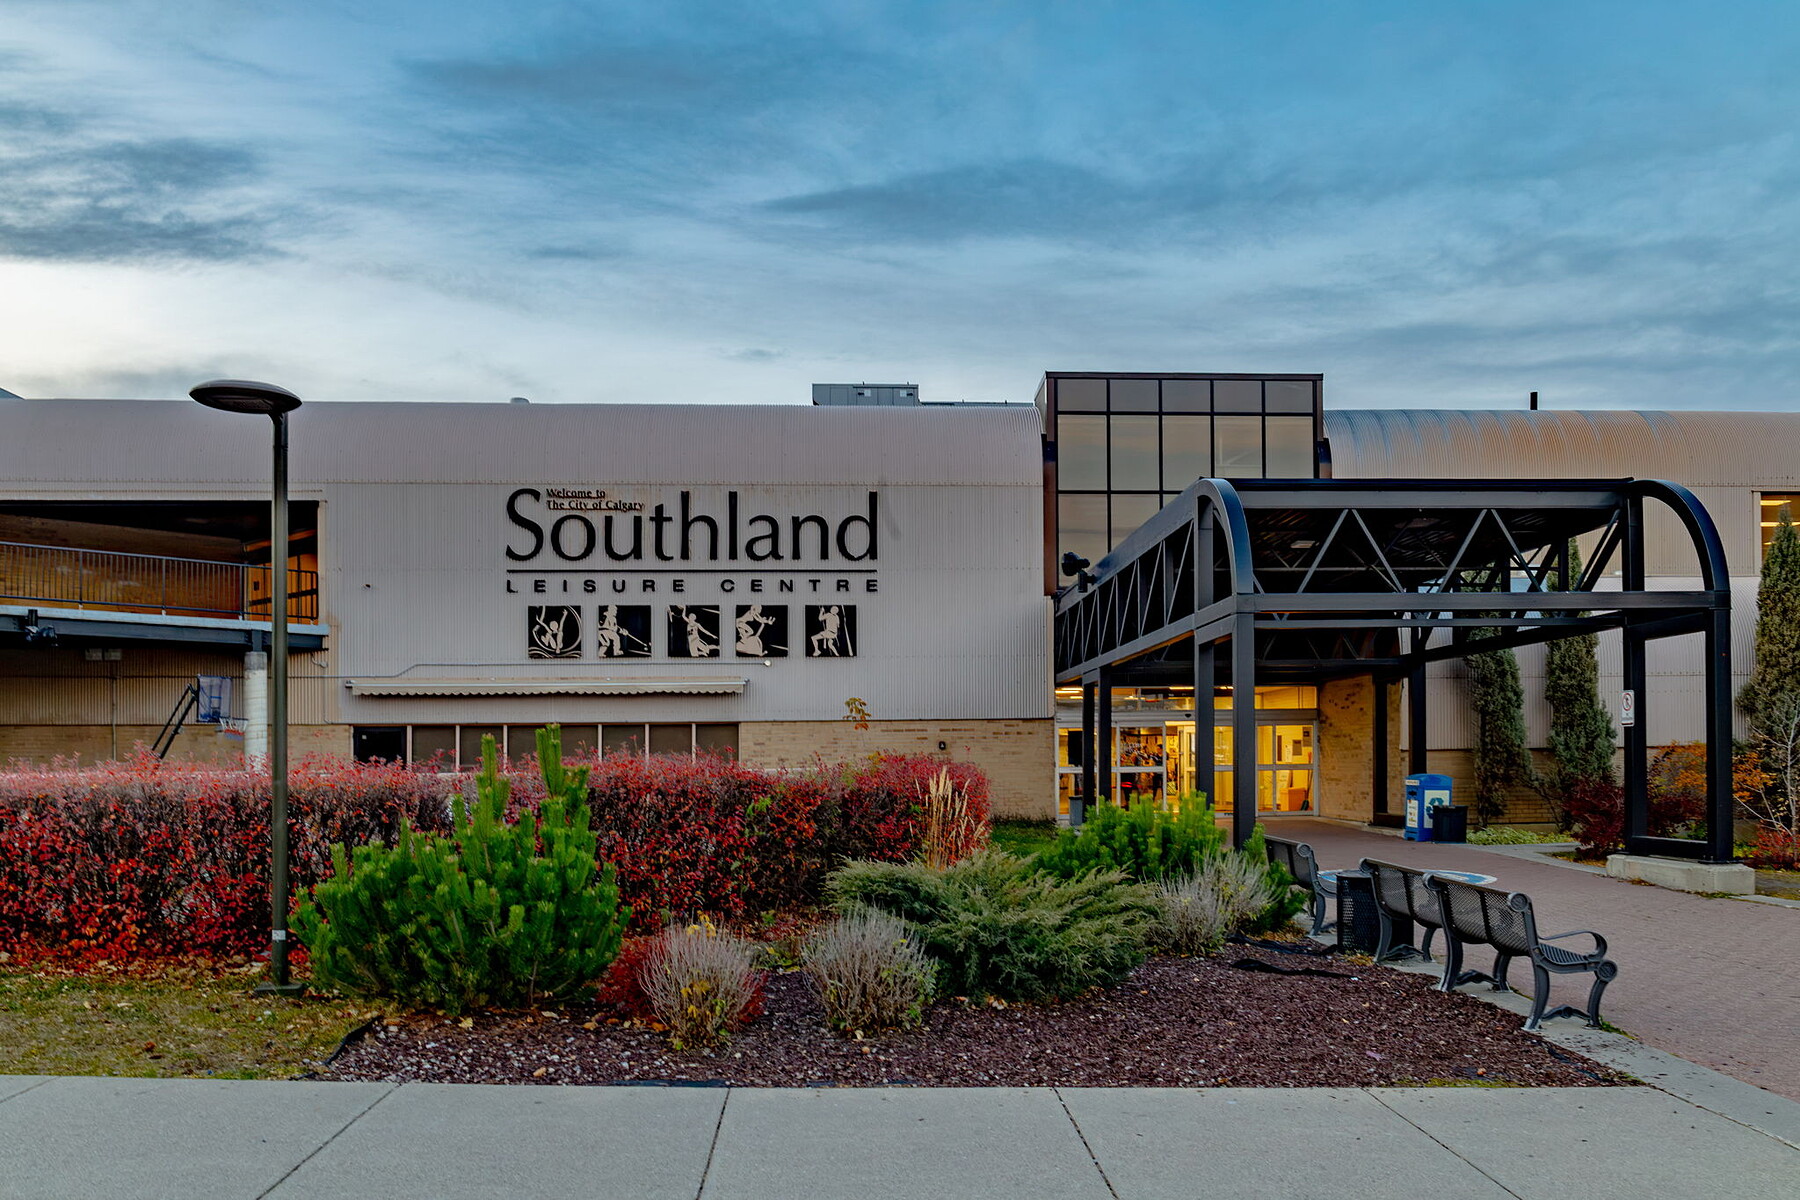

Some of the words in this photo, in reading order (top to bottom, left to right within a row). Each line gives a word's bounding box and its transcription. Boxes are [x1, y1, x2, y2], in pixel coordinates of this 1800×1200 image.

[546, 488, 592, 499] Welcome
[596, 489, 606, 499] to
[547, 500, 565, 511] The
[568, 500, 588, 512] City
[592, 500, 603, 511] of
[605, 500, 644, 513] Calgary
[505, 488, 878, 561] Southland
[506, 579, 685, 593] LEISURE
[720, 579, 878, 593] CENTRE
